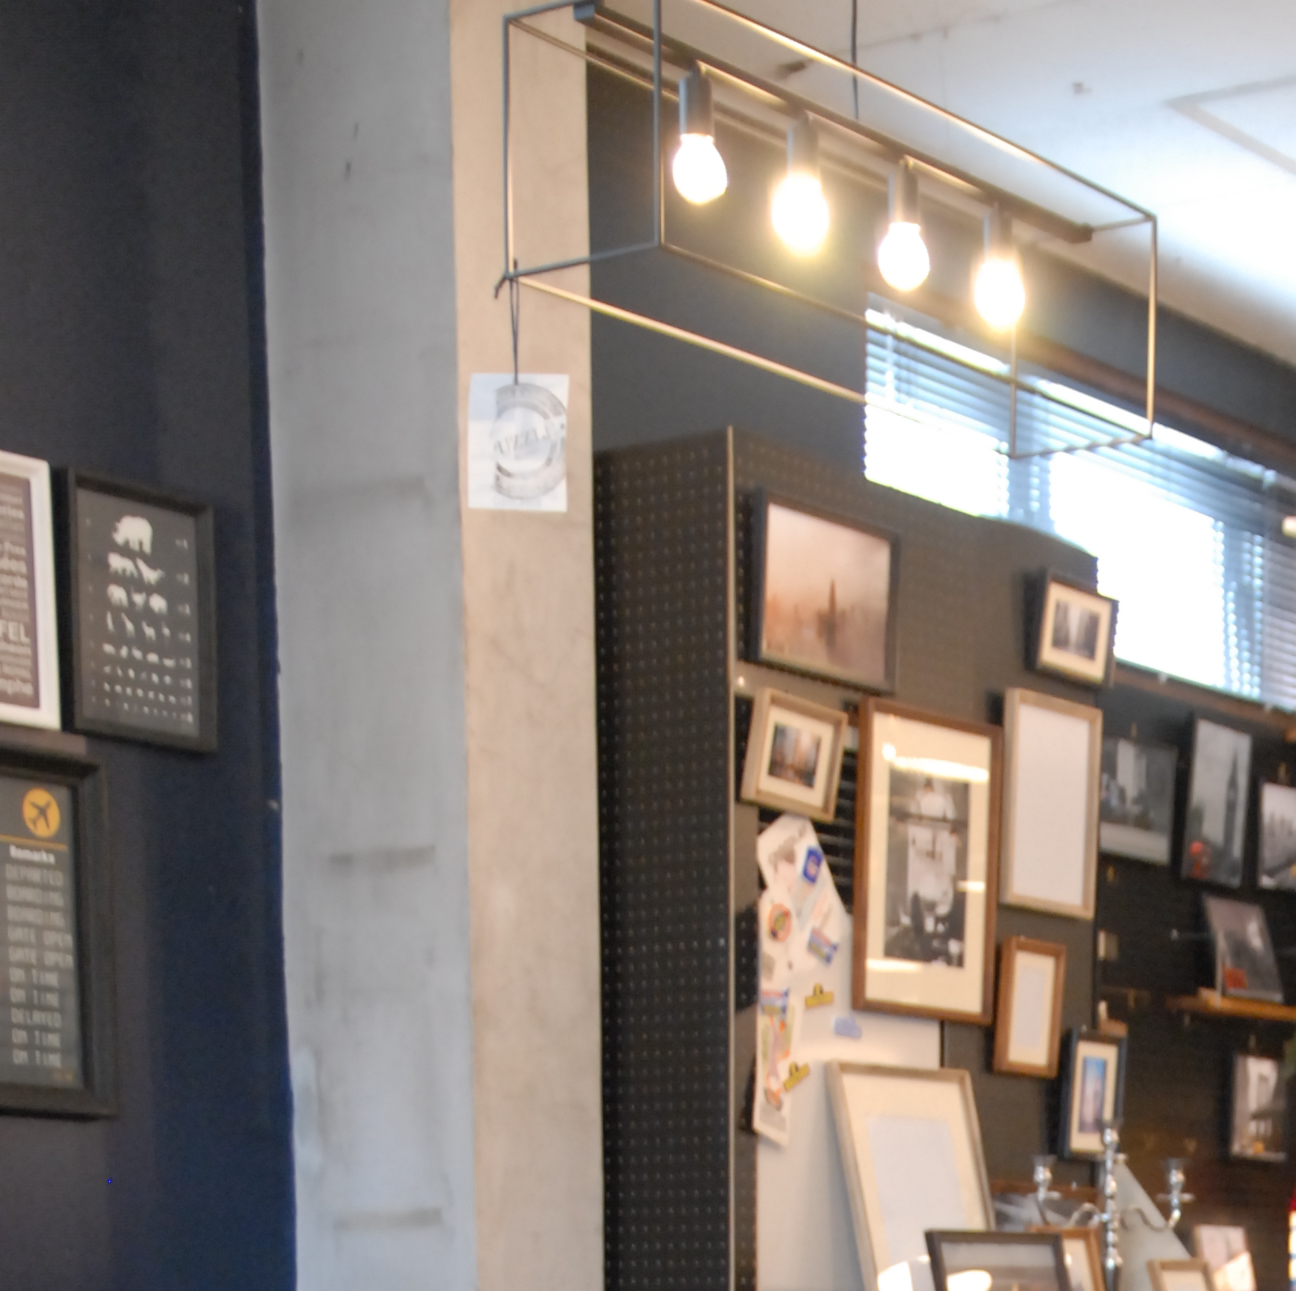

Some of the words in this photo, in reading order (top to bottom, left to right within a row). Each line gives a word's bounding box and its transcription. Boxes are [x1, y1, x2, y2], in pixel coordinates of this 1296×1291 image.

[5, 863, 64, 887] DEPARTED
[6, 884, 64, 907] BOARDING
[7, 904, 65, 927] BOARDING
[8, 925, 36, 945] GATE
[9, 946, 37, 965] GATE
[9, 967, 26, 983] ON
[31, 968, 58, 988] TIME
[10, 987, 27, 1004] ON
[33, 989, 59, 1008] TIME
[11, 1007, 62, 1028] DELAYED
[11, 1027, 28, 1045] ON
[34, 1030, 60, 1048] TIME
[12, 1048, 29, 1065] ON
[35, 1050, 62, 1068] TIME
